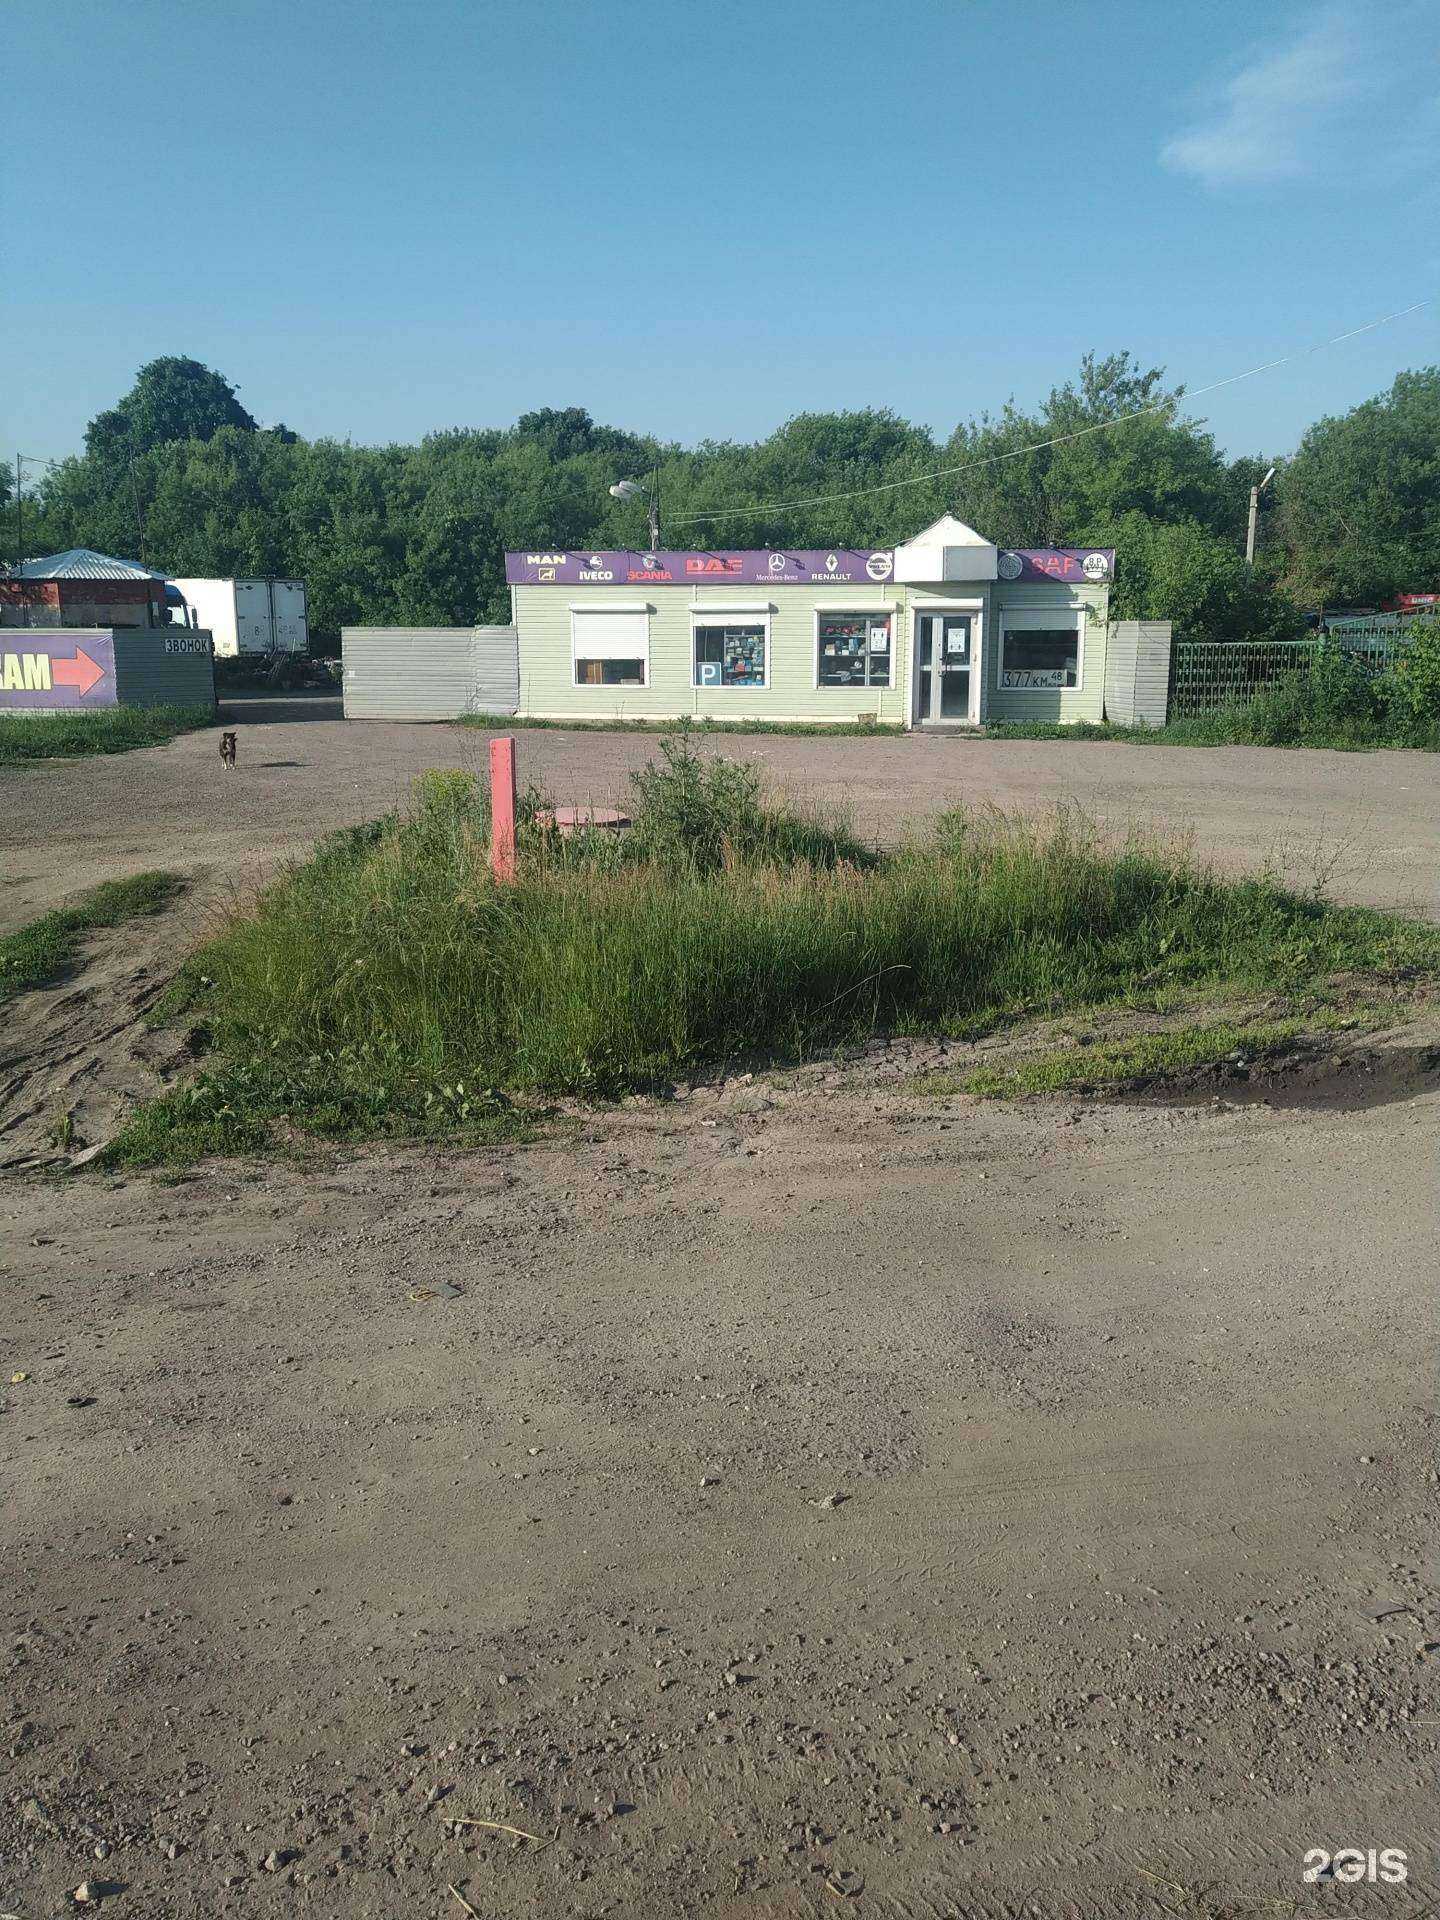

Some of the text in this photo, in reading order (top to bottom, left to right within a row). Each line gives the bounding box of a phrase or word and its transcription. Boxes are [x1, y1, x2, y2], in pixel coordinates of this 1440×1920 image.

[527, 555, 566, 564] MAN
[686, 559, 742, 571] DAF
[1032, 557, 1074, 575] SAF
[579, 571, 613, 580] IVECO
[628, 571, 672, 580] SCANIA
[166, 639, 208, 652] ЗВОНОК
[0, 653, 52, 690] АМ
[702, 665, 716, 686] P
